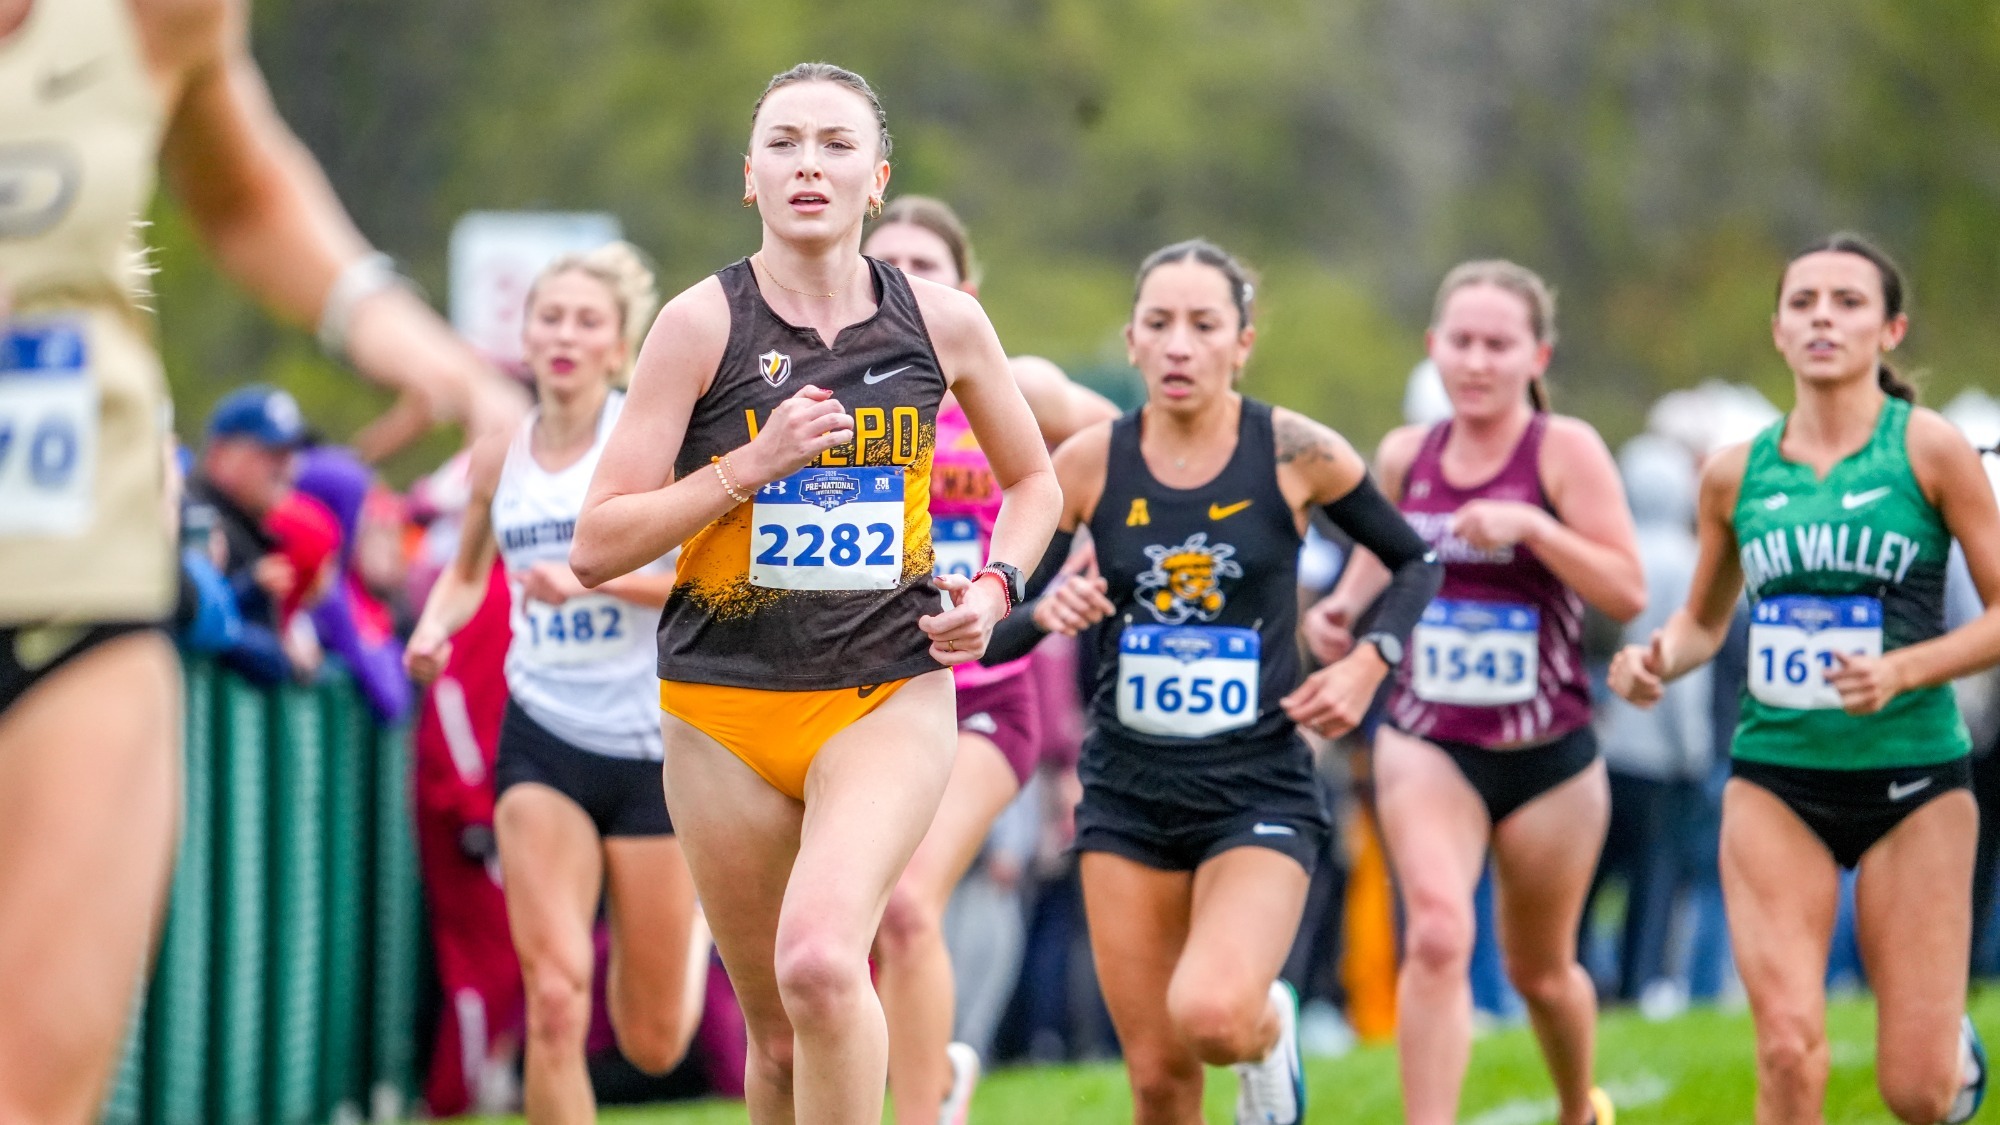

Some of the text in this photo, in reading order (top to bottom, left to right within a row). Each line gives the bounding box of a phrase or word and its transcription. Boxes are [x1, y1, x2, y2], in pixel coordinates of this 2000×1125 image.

[805, 481, 855, 491] PRE-NATIONAL
[756, 522, 895, 567] 2282
[1795, 523, 1920, 584] VALLEY
[528, 606, 623, 646] 1482
[1426, 646, 1526, 684] 1543
[1759, 646, 1866, 684] 161
[1127, 675, 1248, 715] 1650
